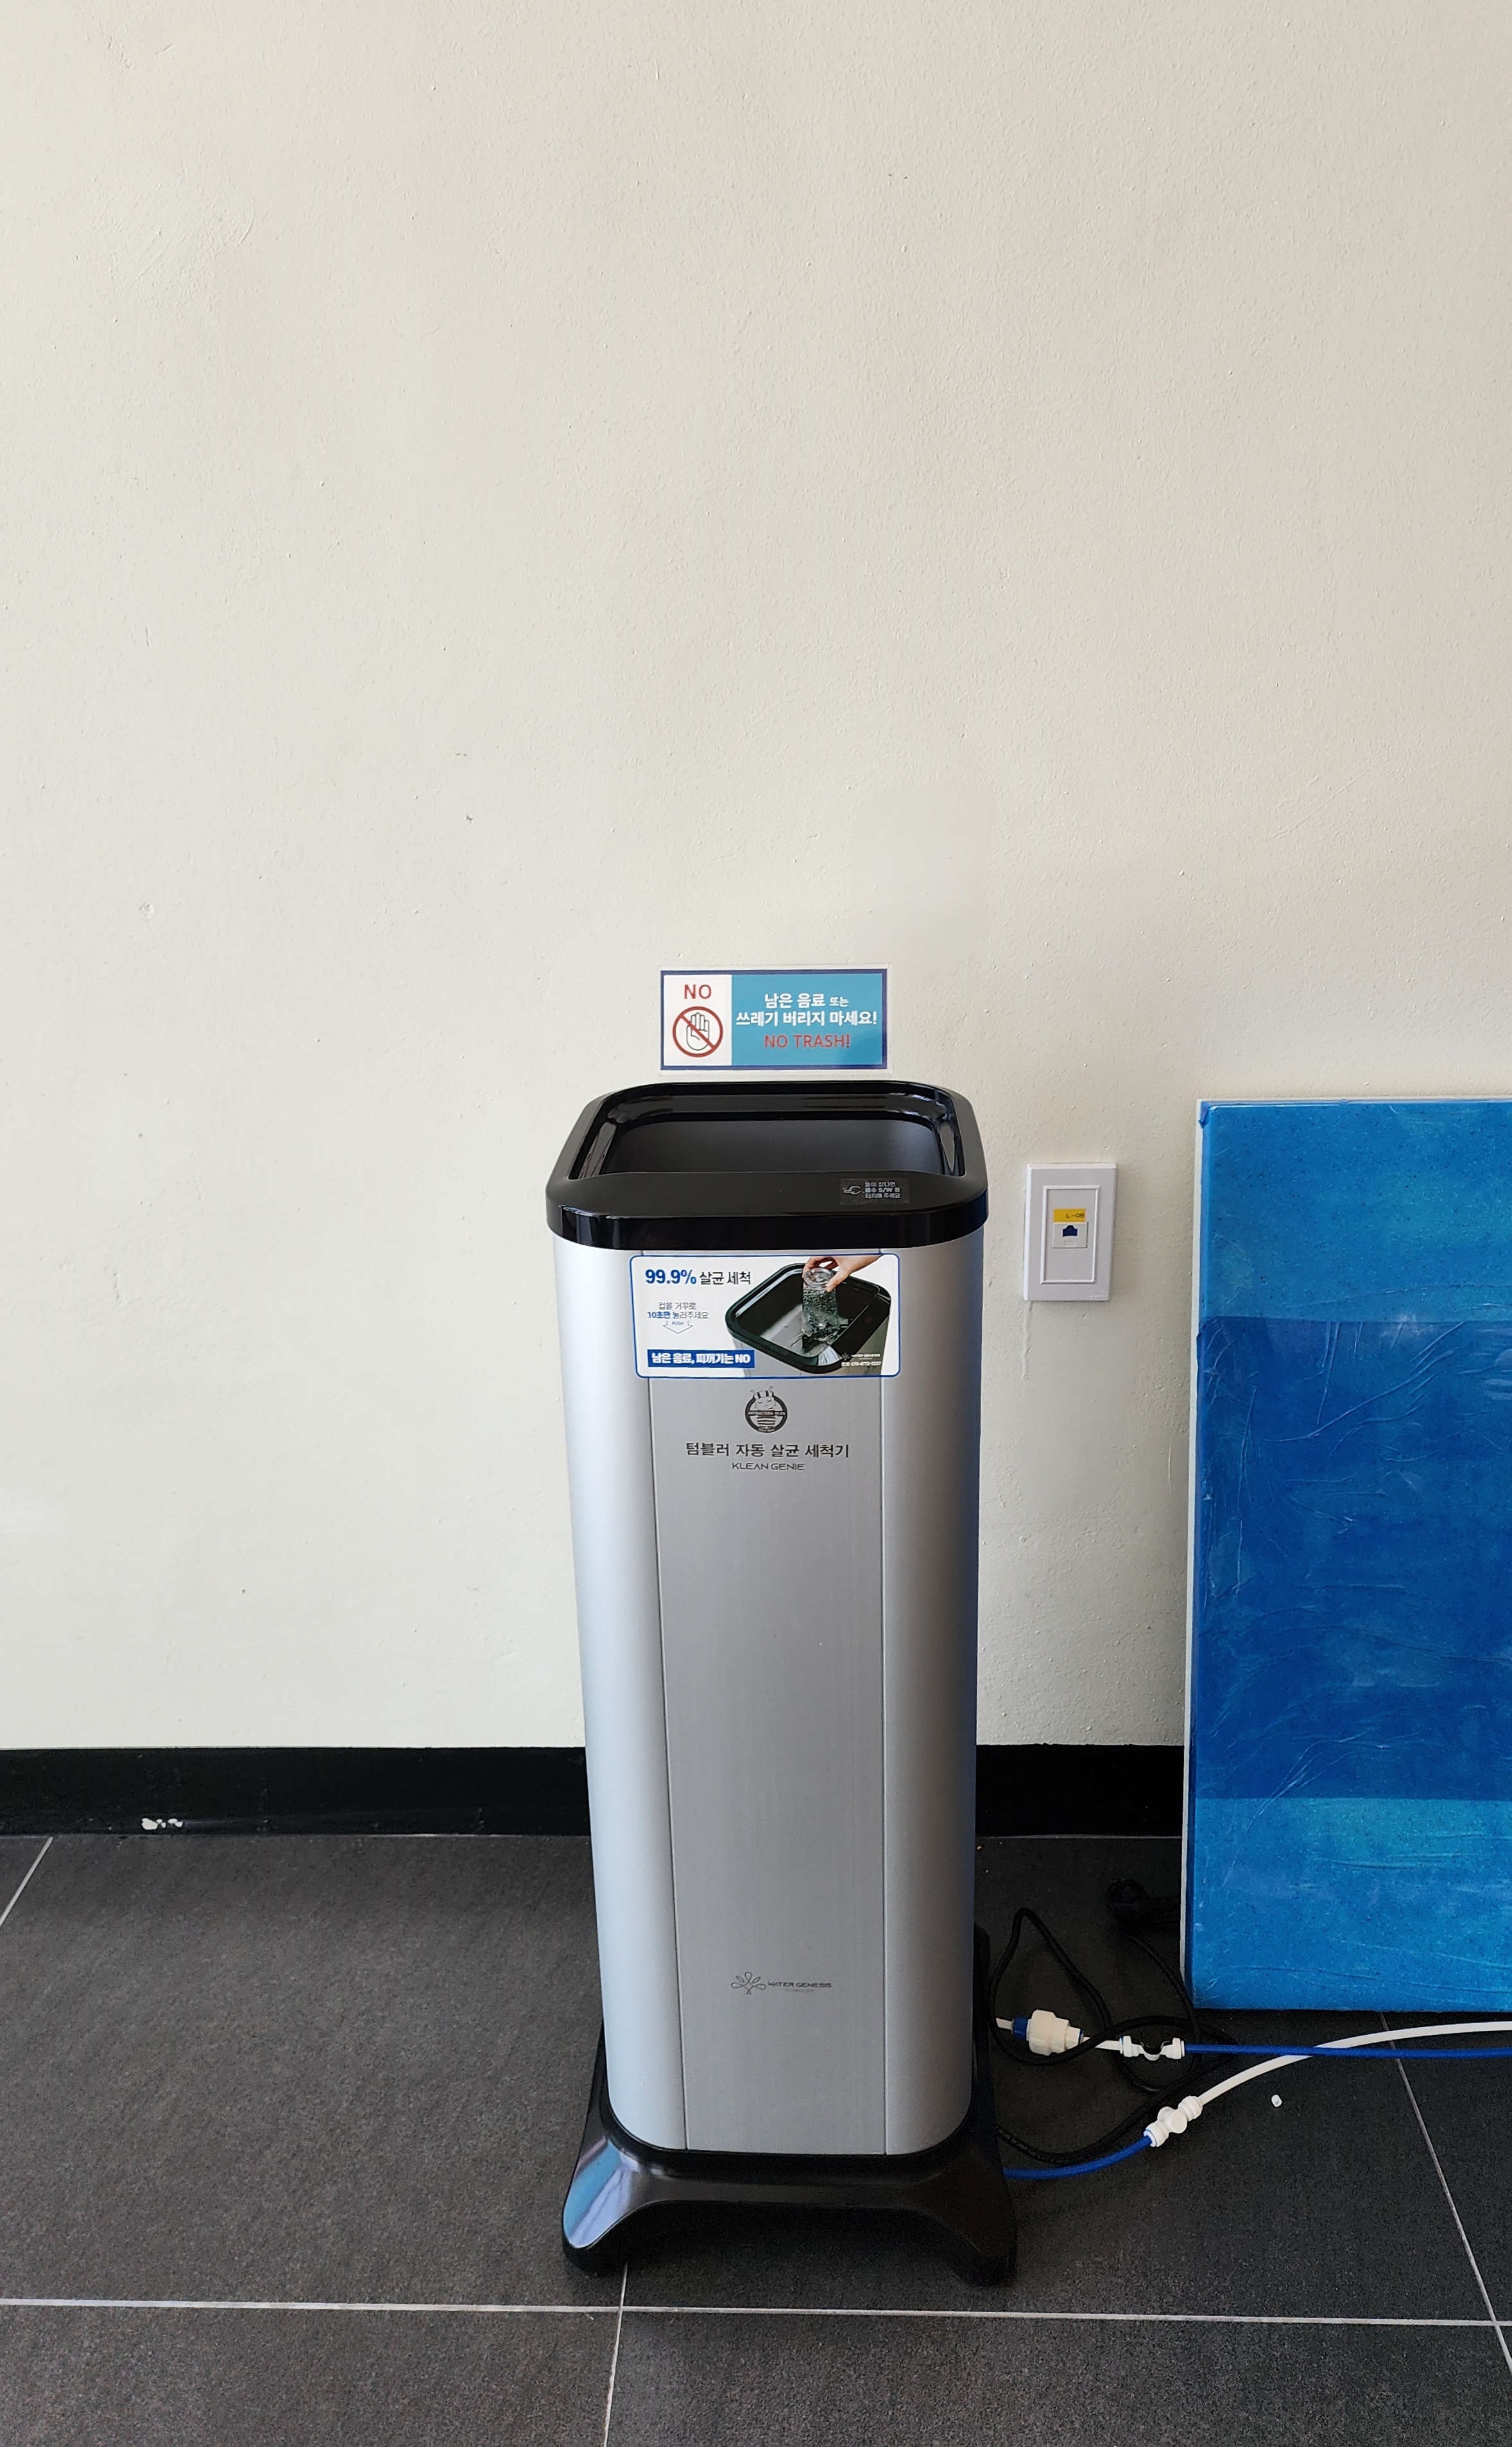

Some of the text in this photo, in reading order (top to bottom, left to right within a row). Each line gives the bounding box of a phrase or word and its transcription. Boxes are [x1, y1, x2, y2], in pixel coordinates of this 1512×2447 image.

[684, 984, 712, 999] NO
[764, 992, 850, 1008] 남은 음료 또는
[735, 1010, 877, 1026] 쓰레기 버리지 마세요!
[764, 1034, 850, 1048] NO TRASH!
[645, 1269, 752, 1285] 99.9% 살균 세척
[658, 1302, 697, 1310] 컵을 거꾸로
[647, 1311, 709, 1319] 10초만 눌러주세요
[651, 1353, 672, 1363] 남은
[673, 1353, 695, 1365] 음료,
[735, 1354, 751, 1363] NO
[686, 1442, 849, 1458] 텀블러 자동 살균 세척기
